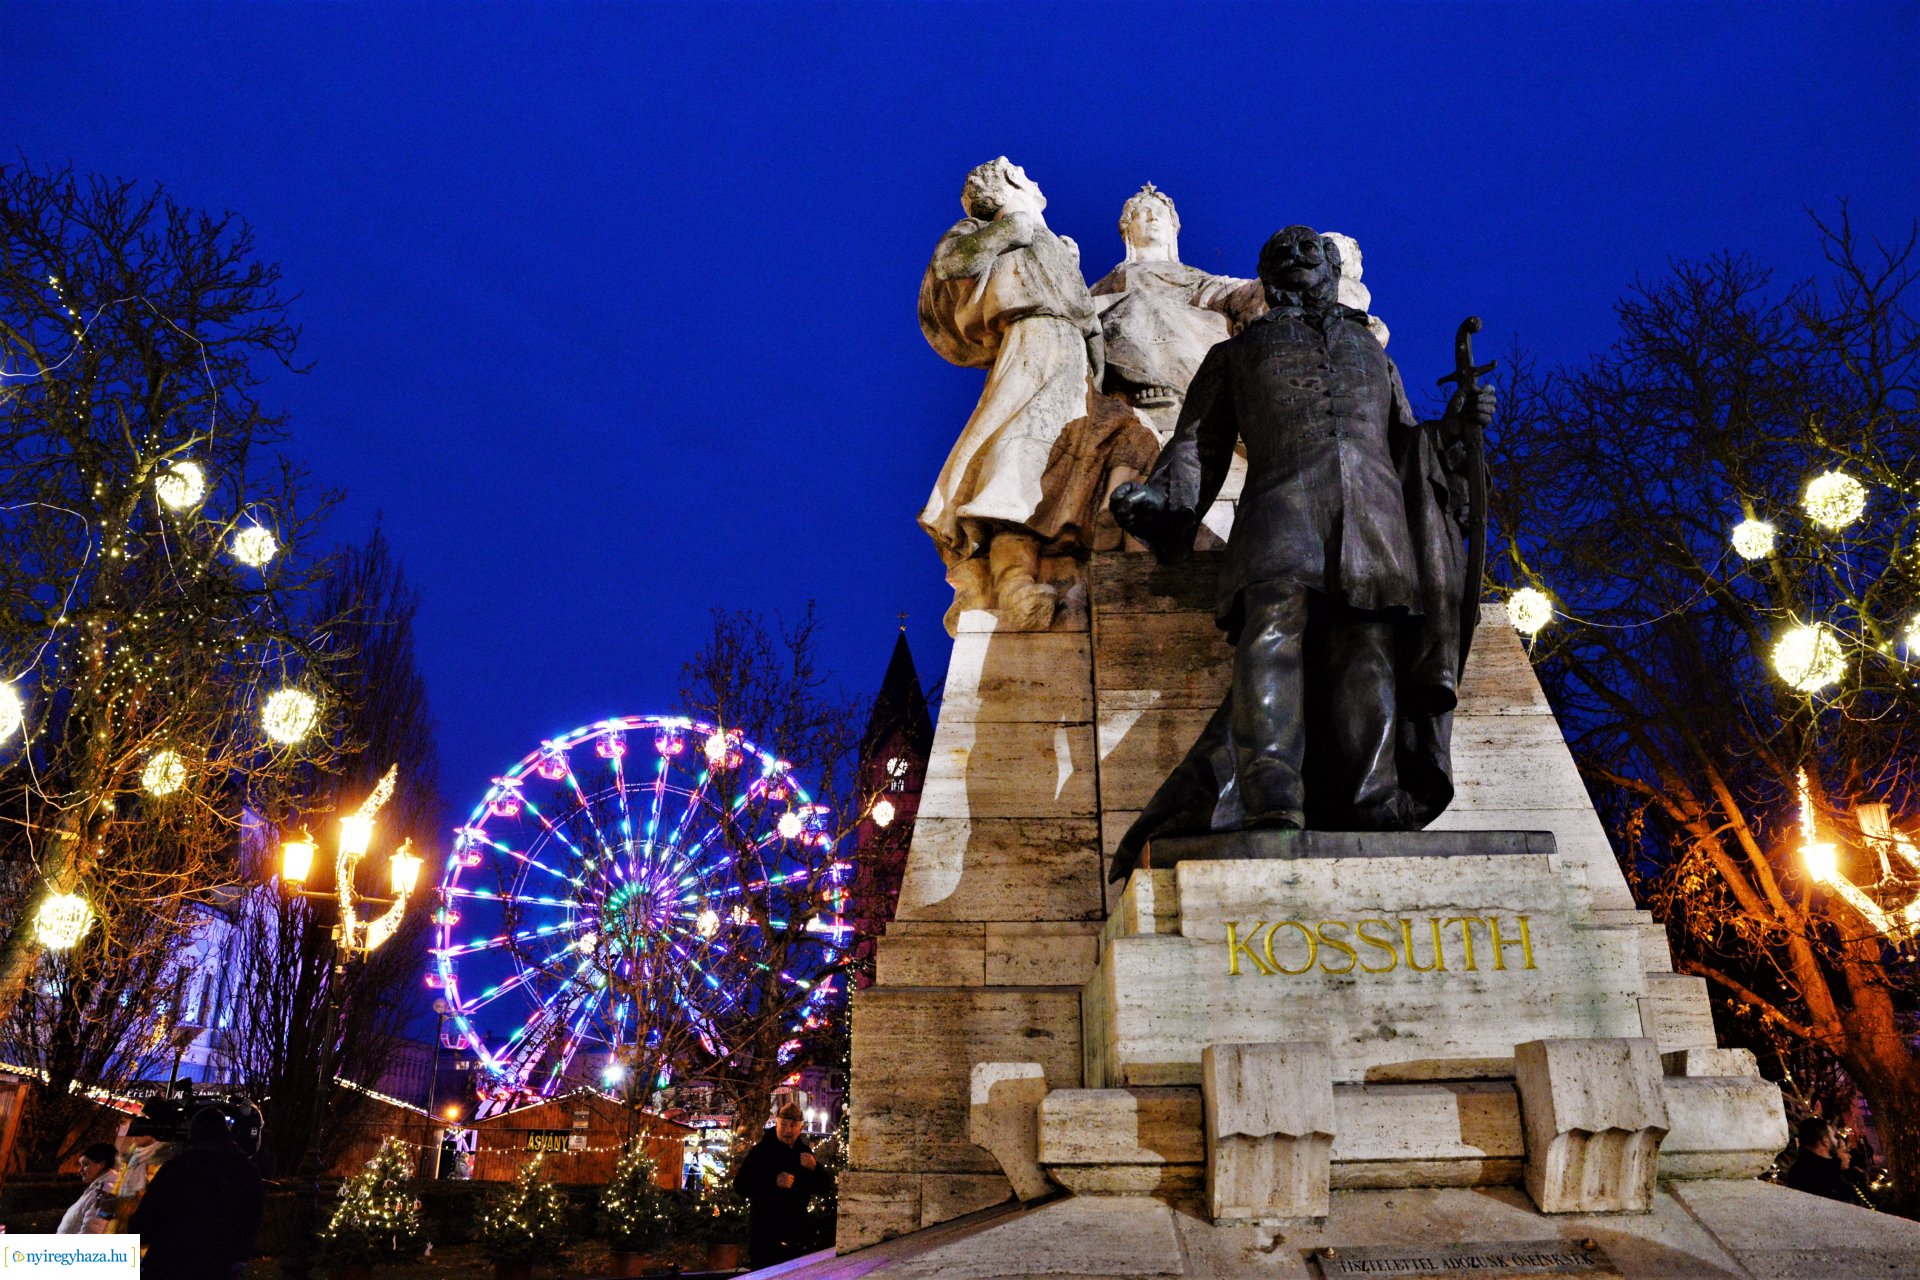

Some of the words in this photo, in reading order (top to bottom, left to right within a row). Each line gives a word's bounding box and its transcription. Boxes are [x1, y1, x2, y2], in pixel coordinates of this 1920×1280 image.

[1223, 915, 1537, 976] KOSSUTH
[528, 1131, 568, 1150] ÁSVÁNY
[1340, 1258, 1438, 1273] TISZTELETTEL
[1443, 1253, 1508, 1269] ADÓZUNK
